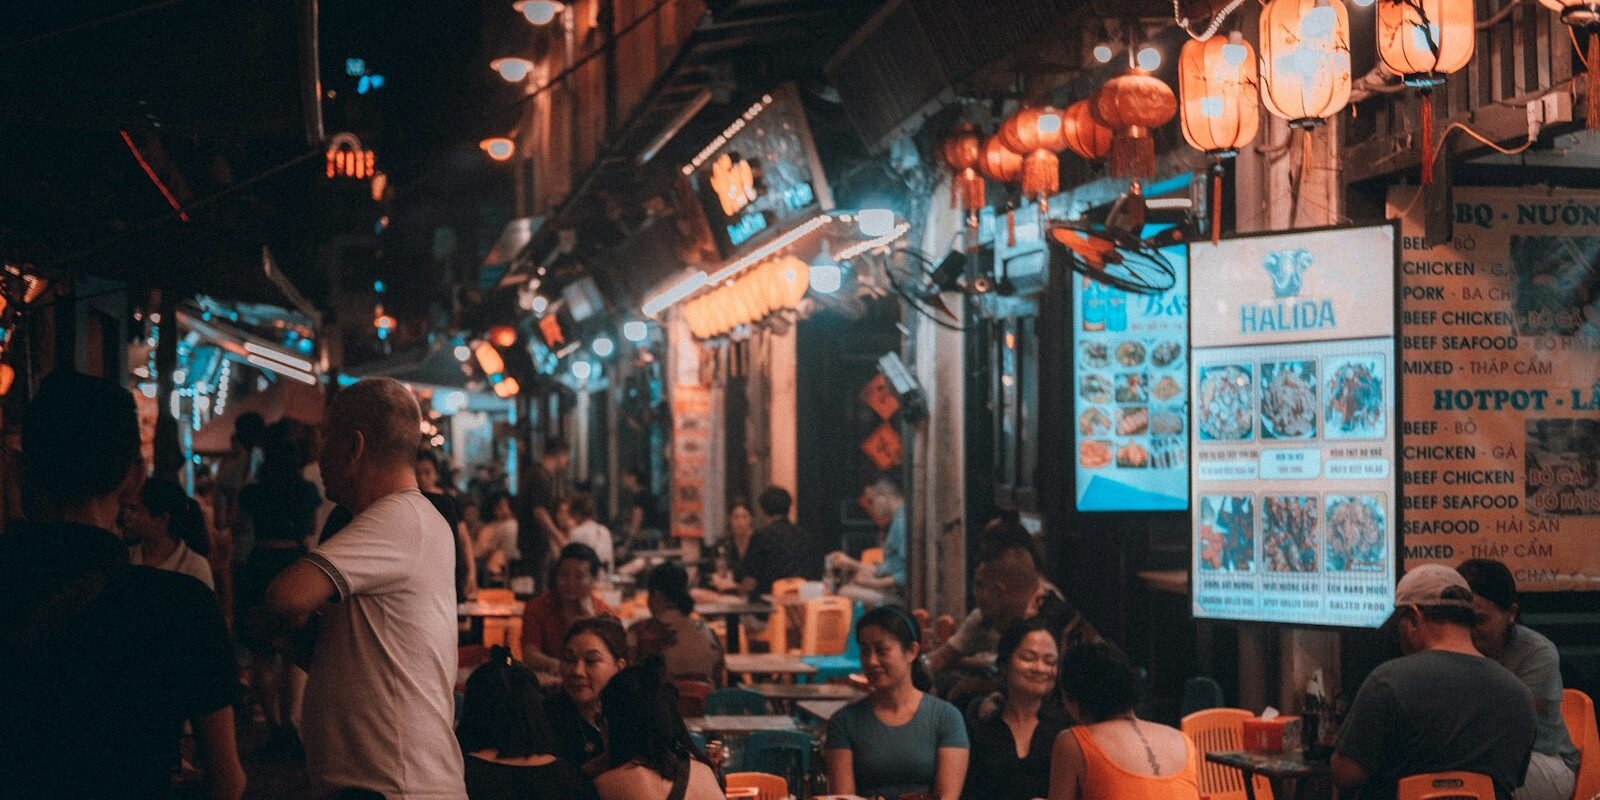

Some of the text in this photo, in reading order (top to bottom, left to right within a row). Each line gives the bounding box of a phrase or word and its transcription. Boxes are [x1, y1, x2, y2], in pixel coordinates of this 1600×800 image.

[1452, 203, 1494, 229] BQ
[1403, 237, 1433, 250] BEE
[1403, 262, 1475, 276] CHICKEN
[1403, 287, 1445, 300] PORK
[1462, 287, 1482, 300] BA
[1241, 299, 1337, 333] HALIDA
[1403, 311, 1437, 325] BEEF
[1442, 311, 1513, 325] CHICKEN
[1403, 336, 1437, 350] BEEF
[1441, 336, 1518, 350] SEAFOOD
[1403, 361, 1453, 375] MIXED
[1433, 389, 1548, 411] HOTPOT
[1403, 421, 1437, 435] BEEF
[1404, 446, 1475, 460] CHICKEN
[1403, 471, 1437, 484] BEEF
[1443, 470, 1514, 484] CHICKEN
[1403, 496, 1437, 509] BEEF
[1443, 495, 1518, 509] SEAFOOD
[1404, 520, 1479, 534] SEAFOOD
[1404, 545, 1453, 558] MIXED
[1515, 569, 1560, 583] CHAY
